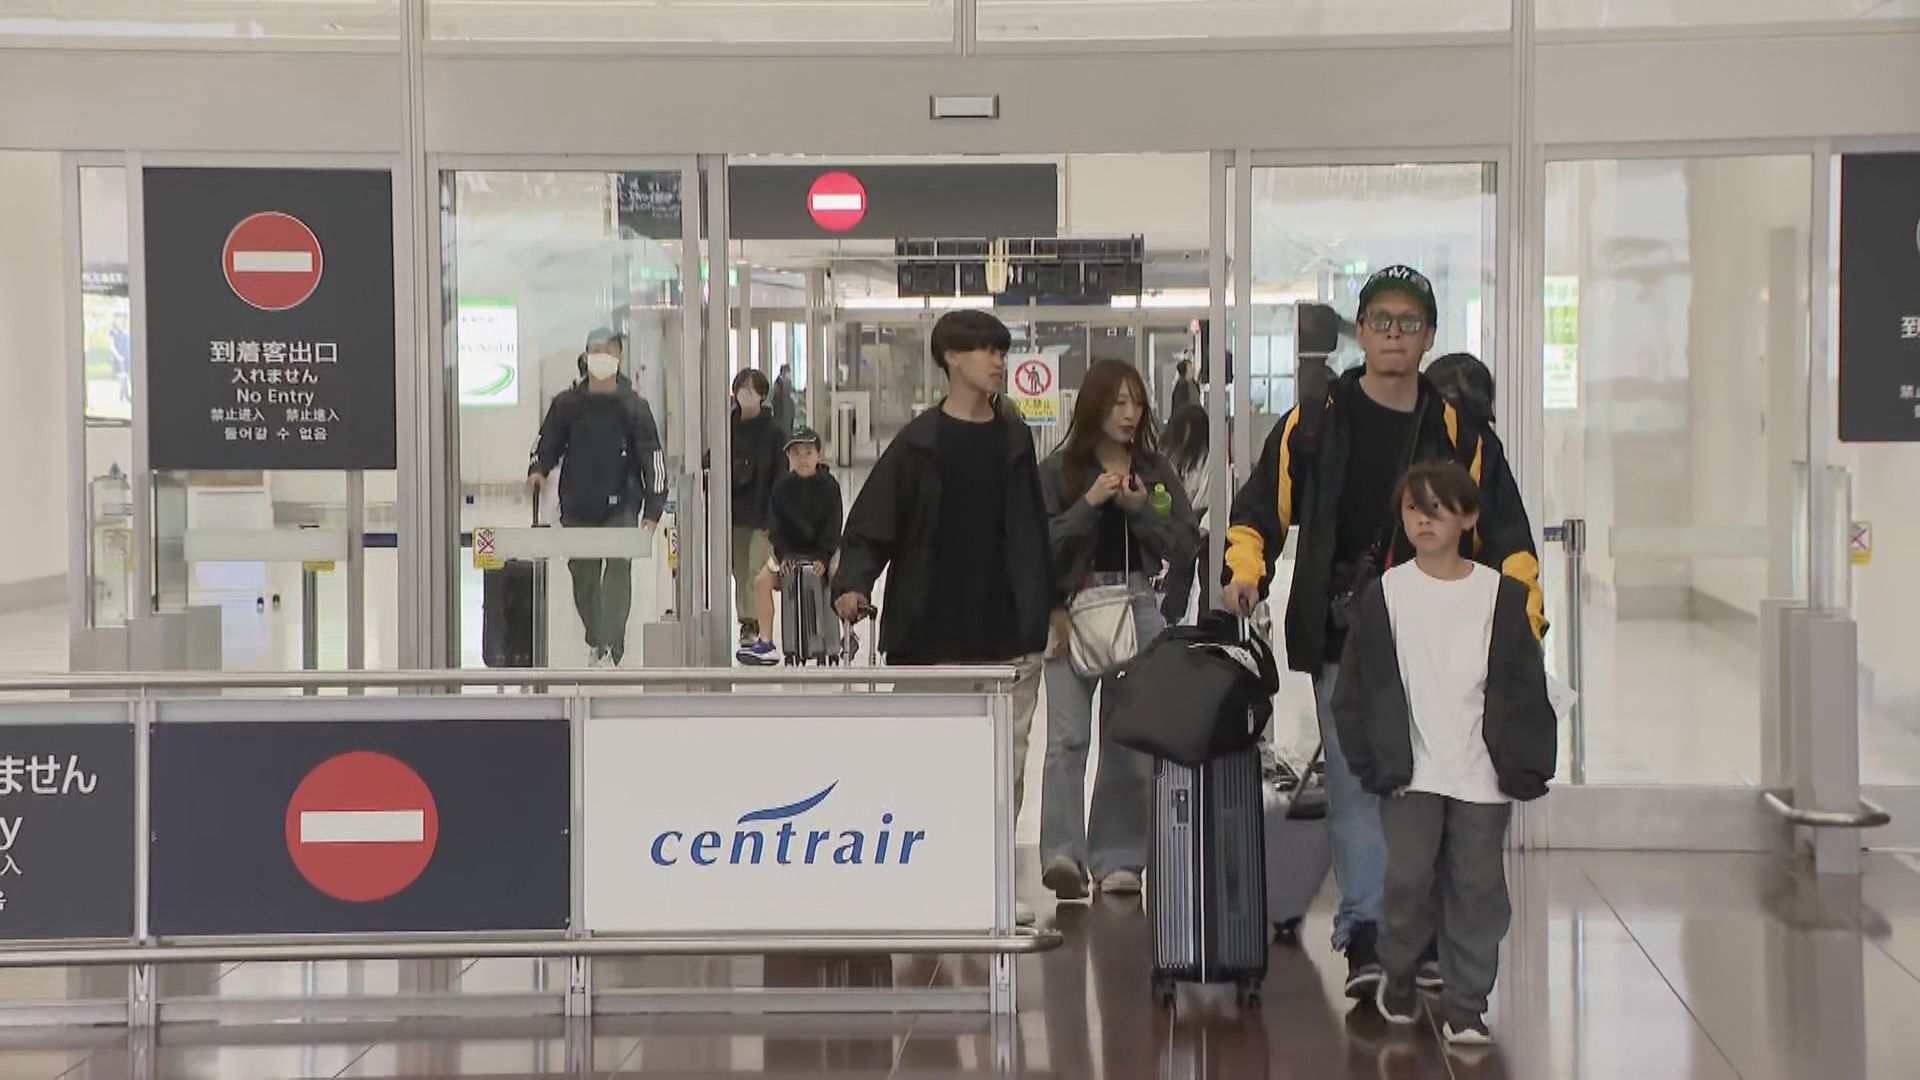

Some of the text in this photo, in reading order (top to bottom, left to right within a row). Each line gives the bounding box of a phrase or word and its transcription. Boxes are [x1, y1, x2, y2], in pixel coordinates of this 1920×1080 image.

[210, 341, 338, 363] 到着客出口
[232, 368, 319, 384] 入れません
[237, 388, 314, 406] No Entry
[225, 427, 267, 441] 들어갈
[276, 427, 290, 440] 수
[650, 812, 925, 866] centrair
